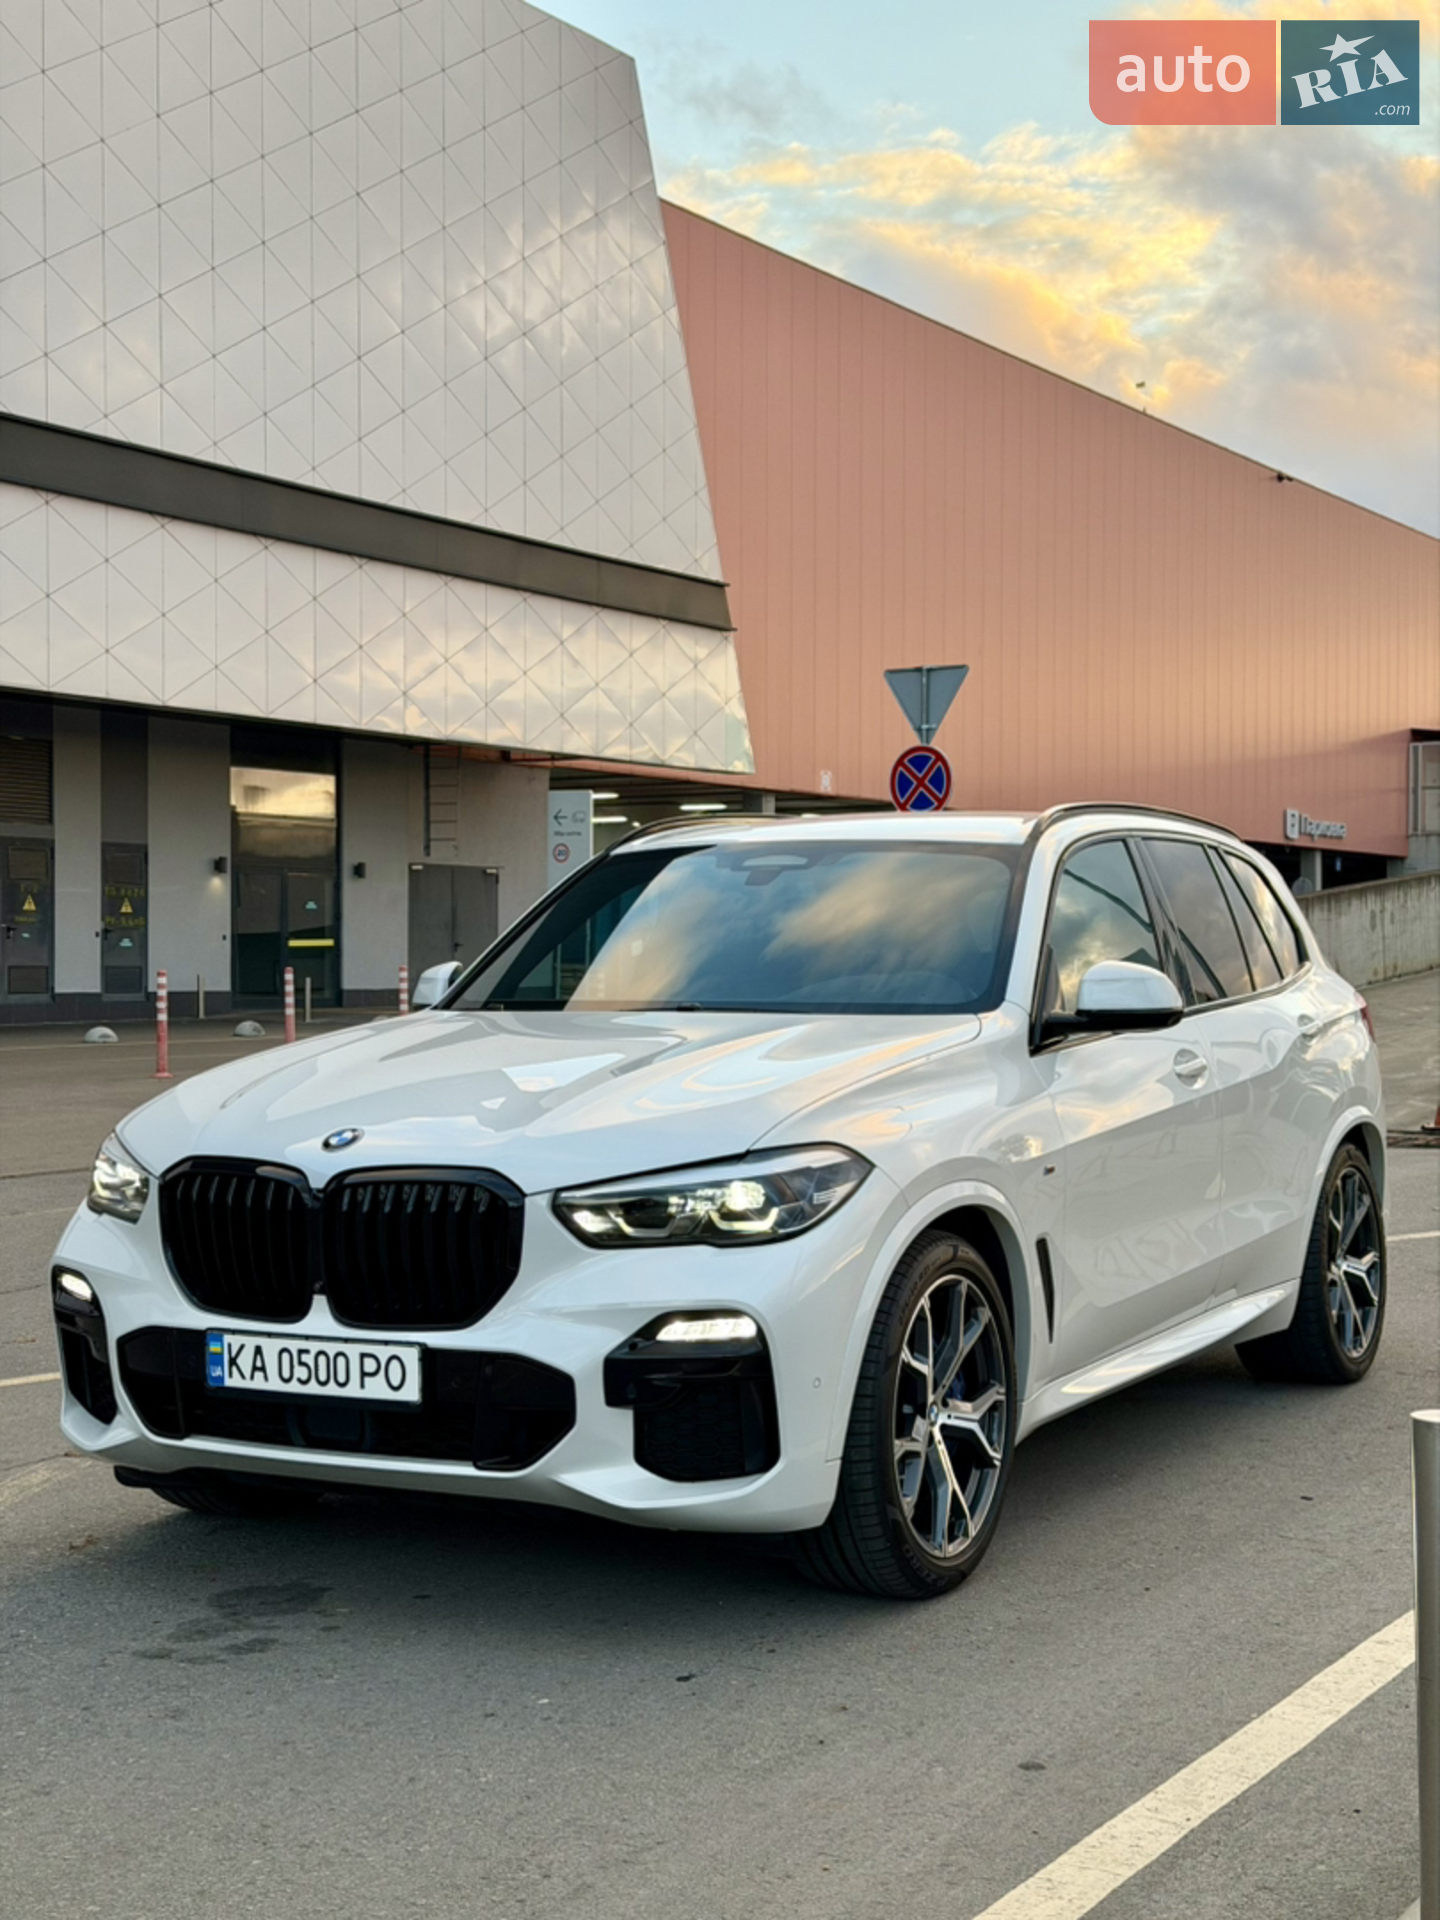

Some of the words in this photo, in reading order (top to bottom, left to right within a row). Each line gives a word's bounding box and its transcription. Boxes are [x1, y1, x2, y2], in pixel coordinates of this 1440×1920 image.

[211, 1366, 222, 1377] UA
[227, 1342, 269, 1383] KA
[277, 1346, 350, 1388] 0500
[359, 1352, 406, 1392] PO
